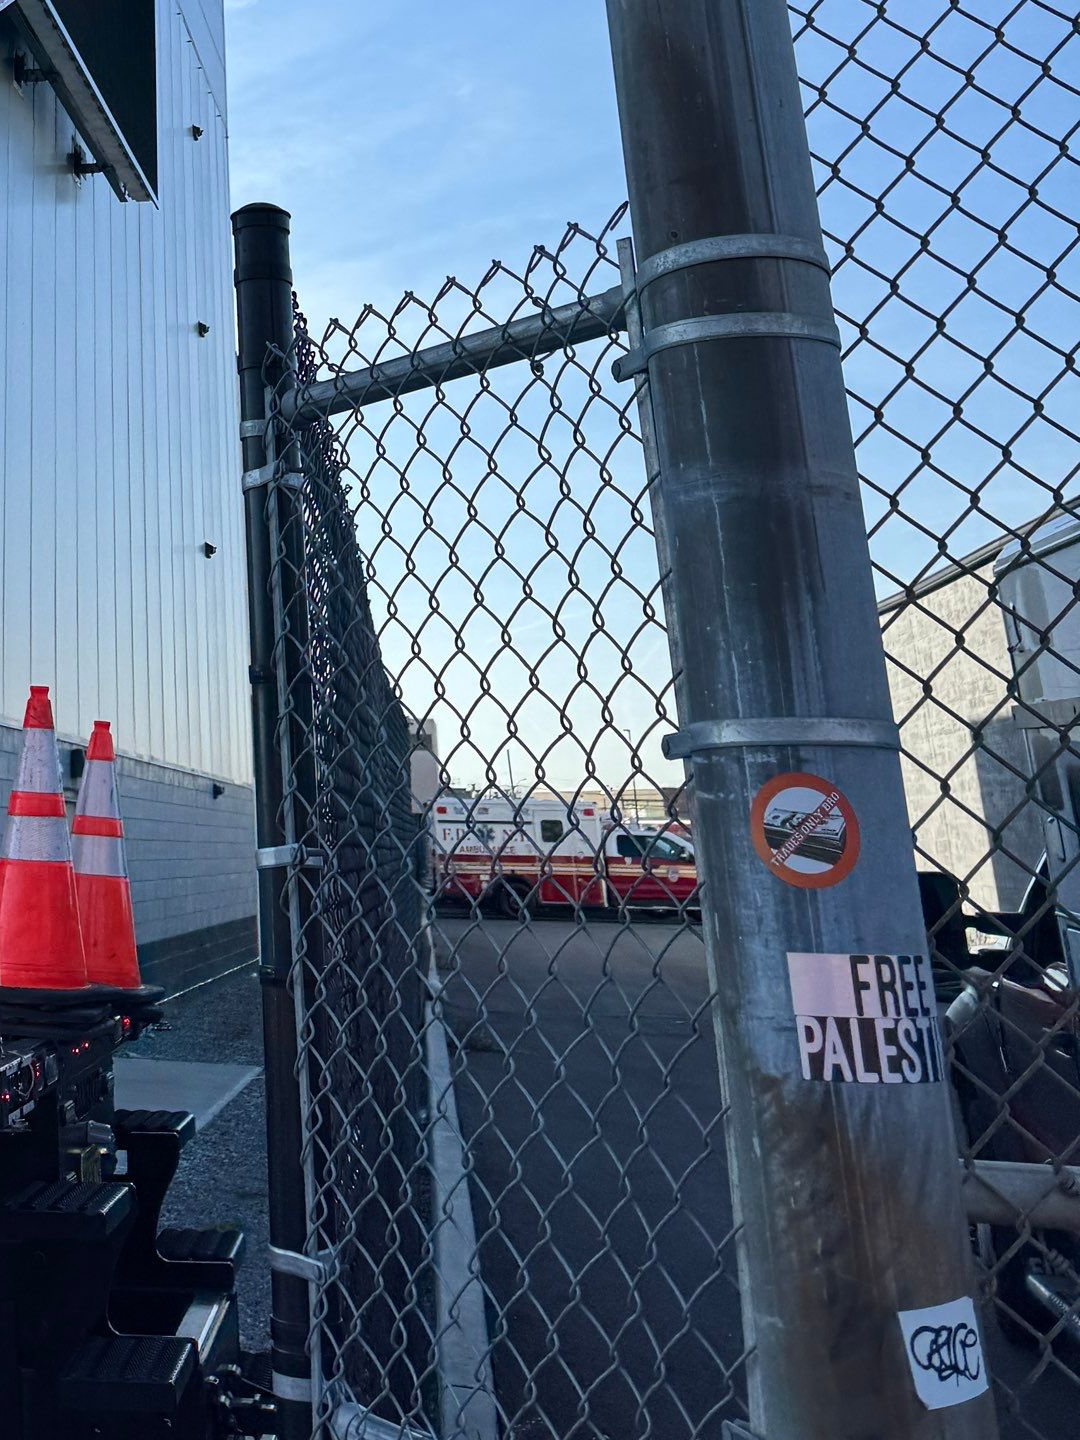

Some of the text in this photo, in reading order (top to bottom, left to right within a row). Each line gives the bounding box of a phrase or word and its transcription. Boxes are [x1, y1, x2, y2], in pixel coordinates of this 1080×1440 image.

[770, 791, 840, 867] TRADES ONLY BRO
[849, 955, 931, 1017] FREE
